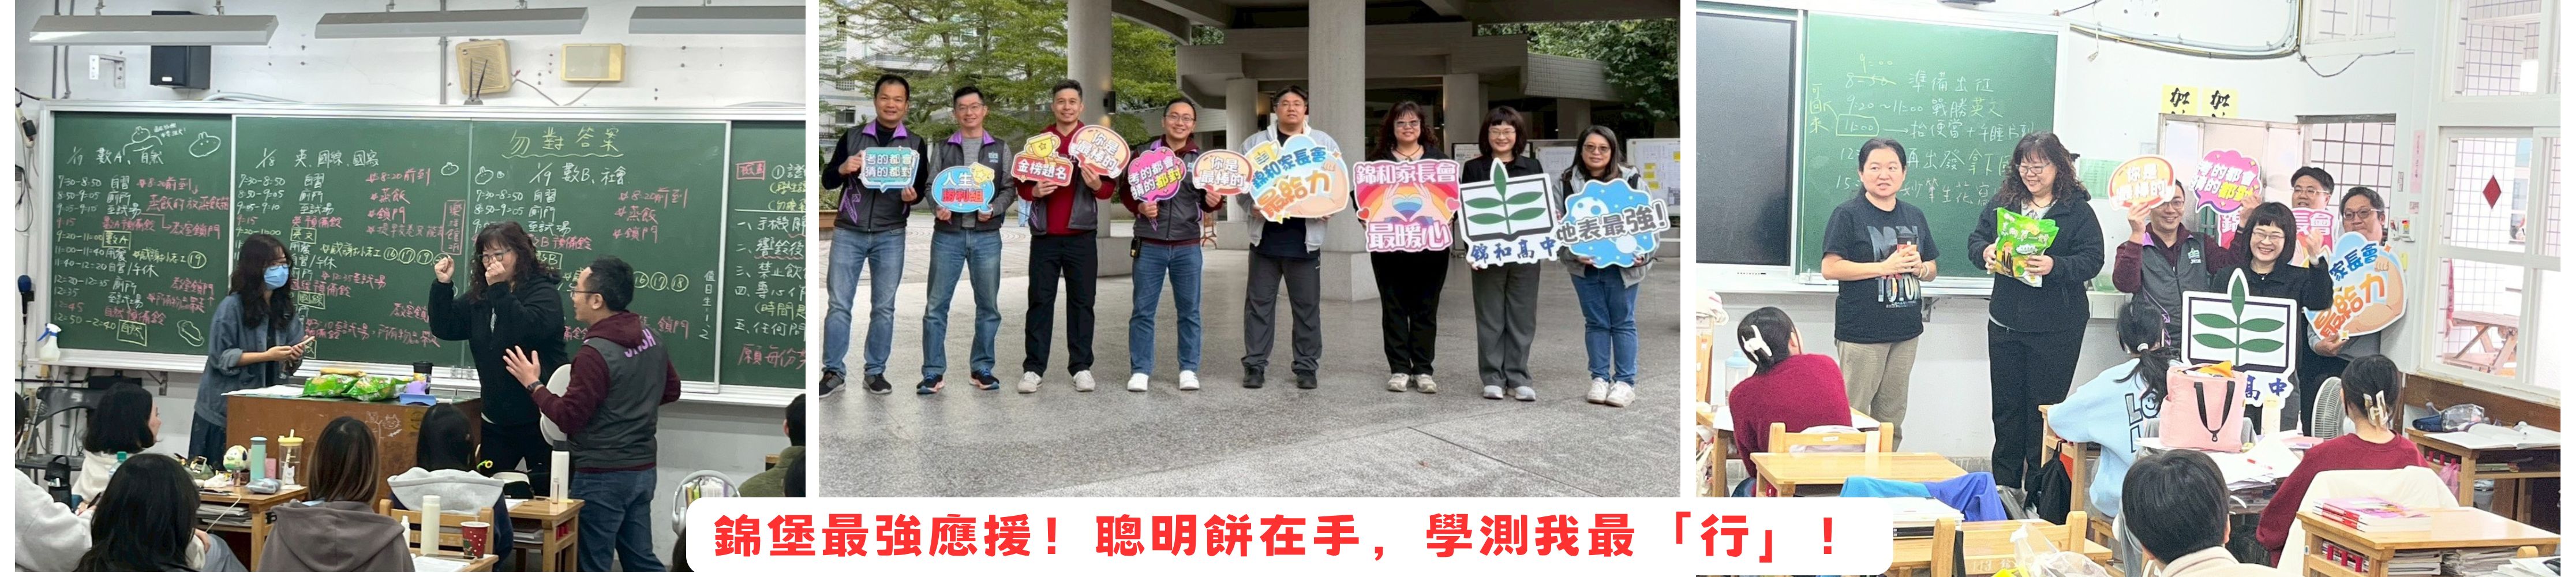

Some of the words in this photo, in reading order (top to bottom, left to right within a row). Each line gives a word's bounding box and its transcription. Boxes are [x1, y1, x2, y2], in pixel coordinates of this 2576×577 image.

[1932, 97, 2004, 118] 戰勝英文
[510, 126, 619, 155] 勿對答案
[1092, 132, 1119, 155] 你是
[1077, 139, 1118, 170] 最棒的
[1211, 157, 1238, 173] 你是
[1017, 159, 1068, 180] 金榜題名
[1201, 170, 1244, 187] 最棒的
[1252, 147, 1327, 189] 錦和家長會
[1356, 163, 1458, 185] 錦和家長會
[110, 175, 130, 190] 自習
[305, 173, 325, 189] 自習
[533, 189, 557, 203] 自習
[942, 189, 983, 202] 勝利組
[1256, 170, 1332, 217] 最給力
[1368, 222, 1451, 249] 最暖心
[1470, 237, 1556, 263] 錦和高中
